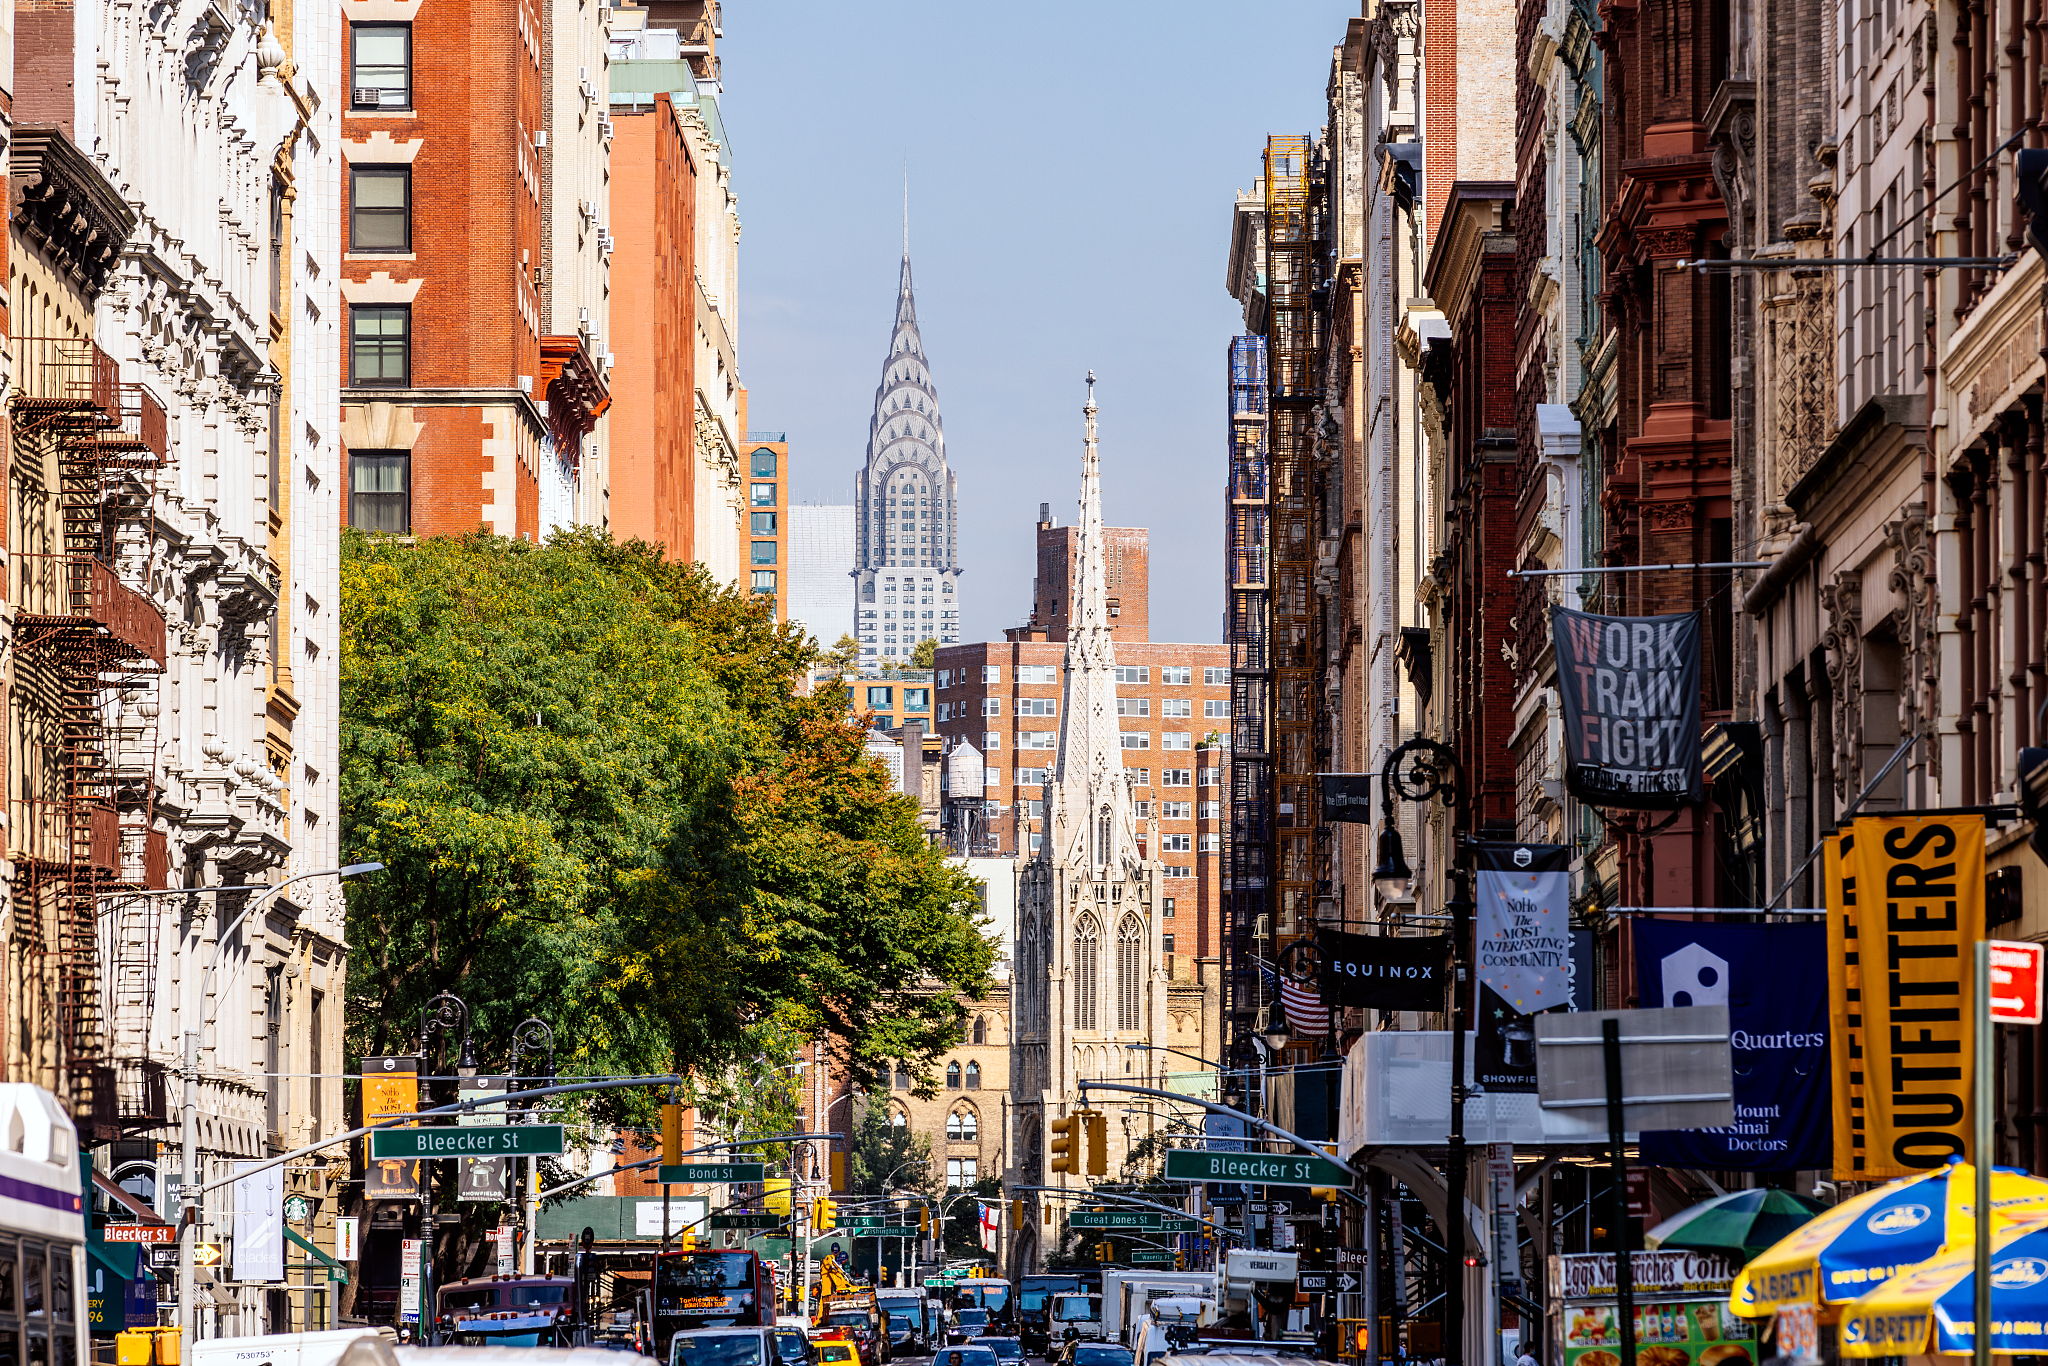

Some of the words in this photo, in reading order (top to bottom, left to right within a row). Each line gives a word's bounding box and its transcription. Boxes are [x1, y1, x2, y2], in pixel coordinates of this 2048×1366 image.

[1568, 617, 1682, 669] WORK
[1574, 665, 1681, 717] TRAIN
[1581, 715, 1681, 766] FIGHT
[1626, 773, 1634, 791] &
[1638, 773, 1680, 792] FITNESS
[1507, 897, 1537, 912] NoHo
[1515, 915, 1532, 926] The
[1503, 926, 1541, 940] MOST
[1482, 937, 1564, 953] INTERESTING
[1483, 951, 1563, 967] COMMUNITY
[1334, 960, 1433, 979] EQUINOX
[1884, 823, 1966, 1169] OUTFITTERS
[1731, 1030, 1824, 1050] Quarters
[1482, 1074, 1537, 1084] SHOWFIE
[380, 1104, 402, 1113] MOST
[1734, 1104, 1781, 1118] Mount
[1728, 1120, 1770, 1135] Sinai
[417, 1133, 495, 1150] Bleecker
[502, 1132, 518, 1149] St
[1728, 1137, 1788, 1151] Doctors
[689, 1168, 718, 1179] Bond
[723, 1168, 733, 1179] St
[1210, 1158, 1287, 1177] Bleecker
[1295, 1163, 1310, 1178] St
[730, 1218, 737, 1226] W
[742, 1218, 747, 1226] 3
[752, 1217, 760, 1227] St
[1084, 1215, 1108, 1224] Great
[1112, 1216, 1136, 1224] Jones
[1140, 1215, 1147, 1224] St
[104, 1227, 153, 1241] Bleecker
[156, 1228, 168, 1241] St
[486, 1232, 498, 1241] Bon
[404, 1241, 409, 1249] 3
[157, 1250, 179, 1260] ONE
[238, 1251, 278, 1264] blades
[1341, 1251, 1367, 1264] Bleec
[1250, 1261, 1278, 1270] VERSALIFT
[1307, 1278, 1326, 1287] ONE
[1564, 1257, 1596, 1296] Eggs
[1600, 1255, 1674, 1288] Saiches
[403, 1279, 408, 1287] 2
[88, 1311, 104, 1323] 96
[236, 1351, 271, 1360] 7530753
